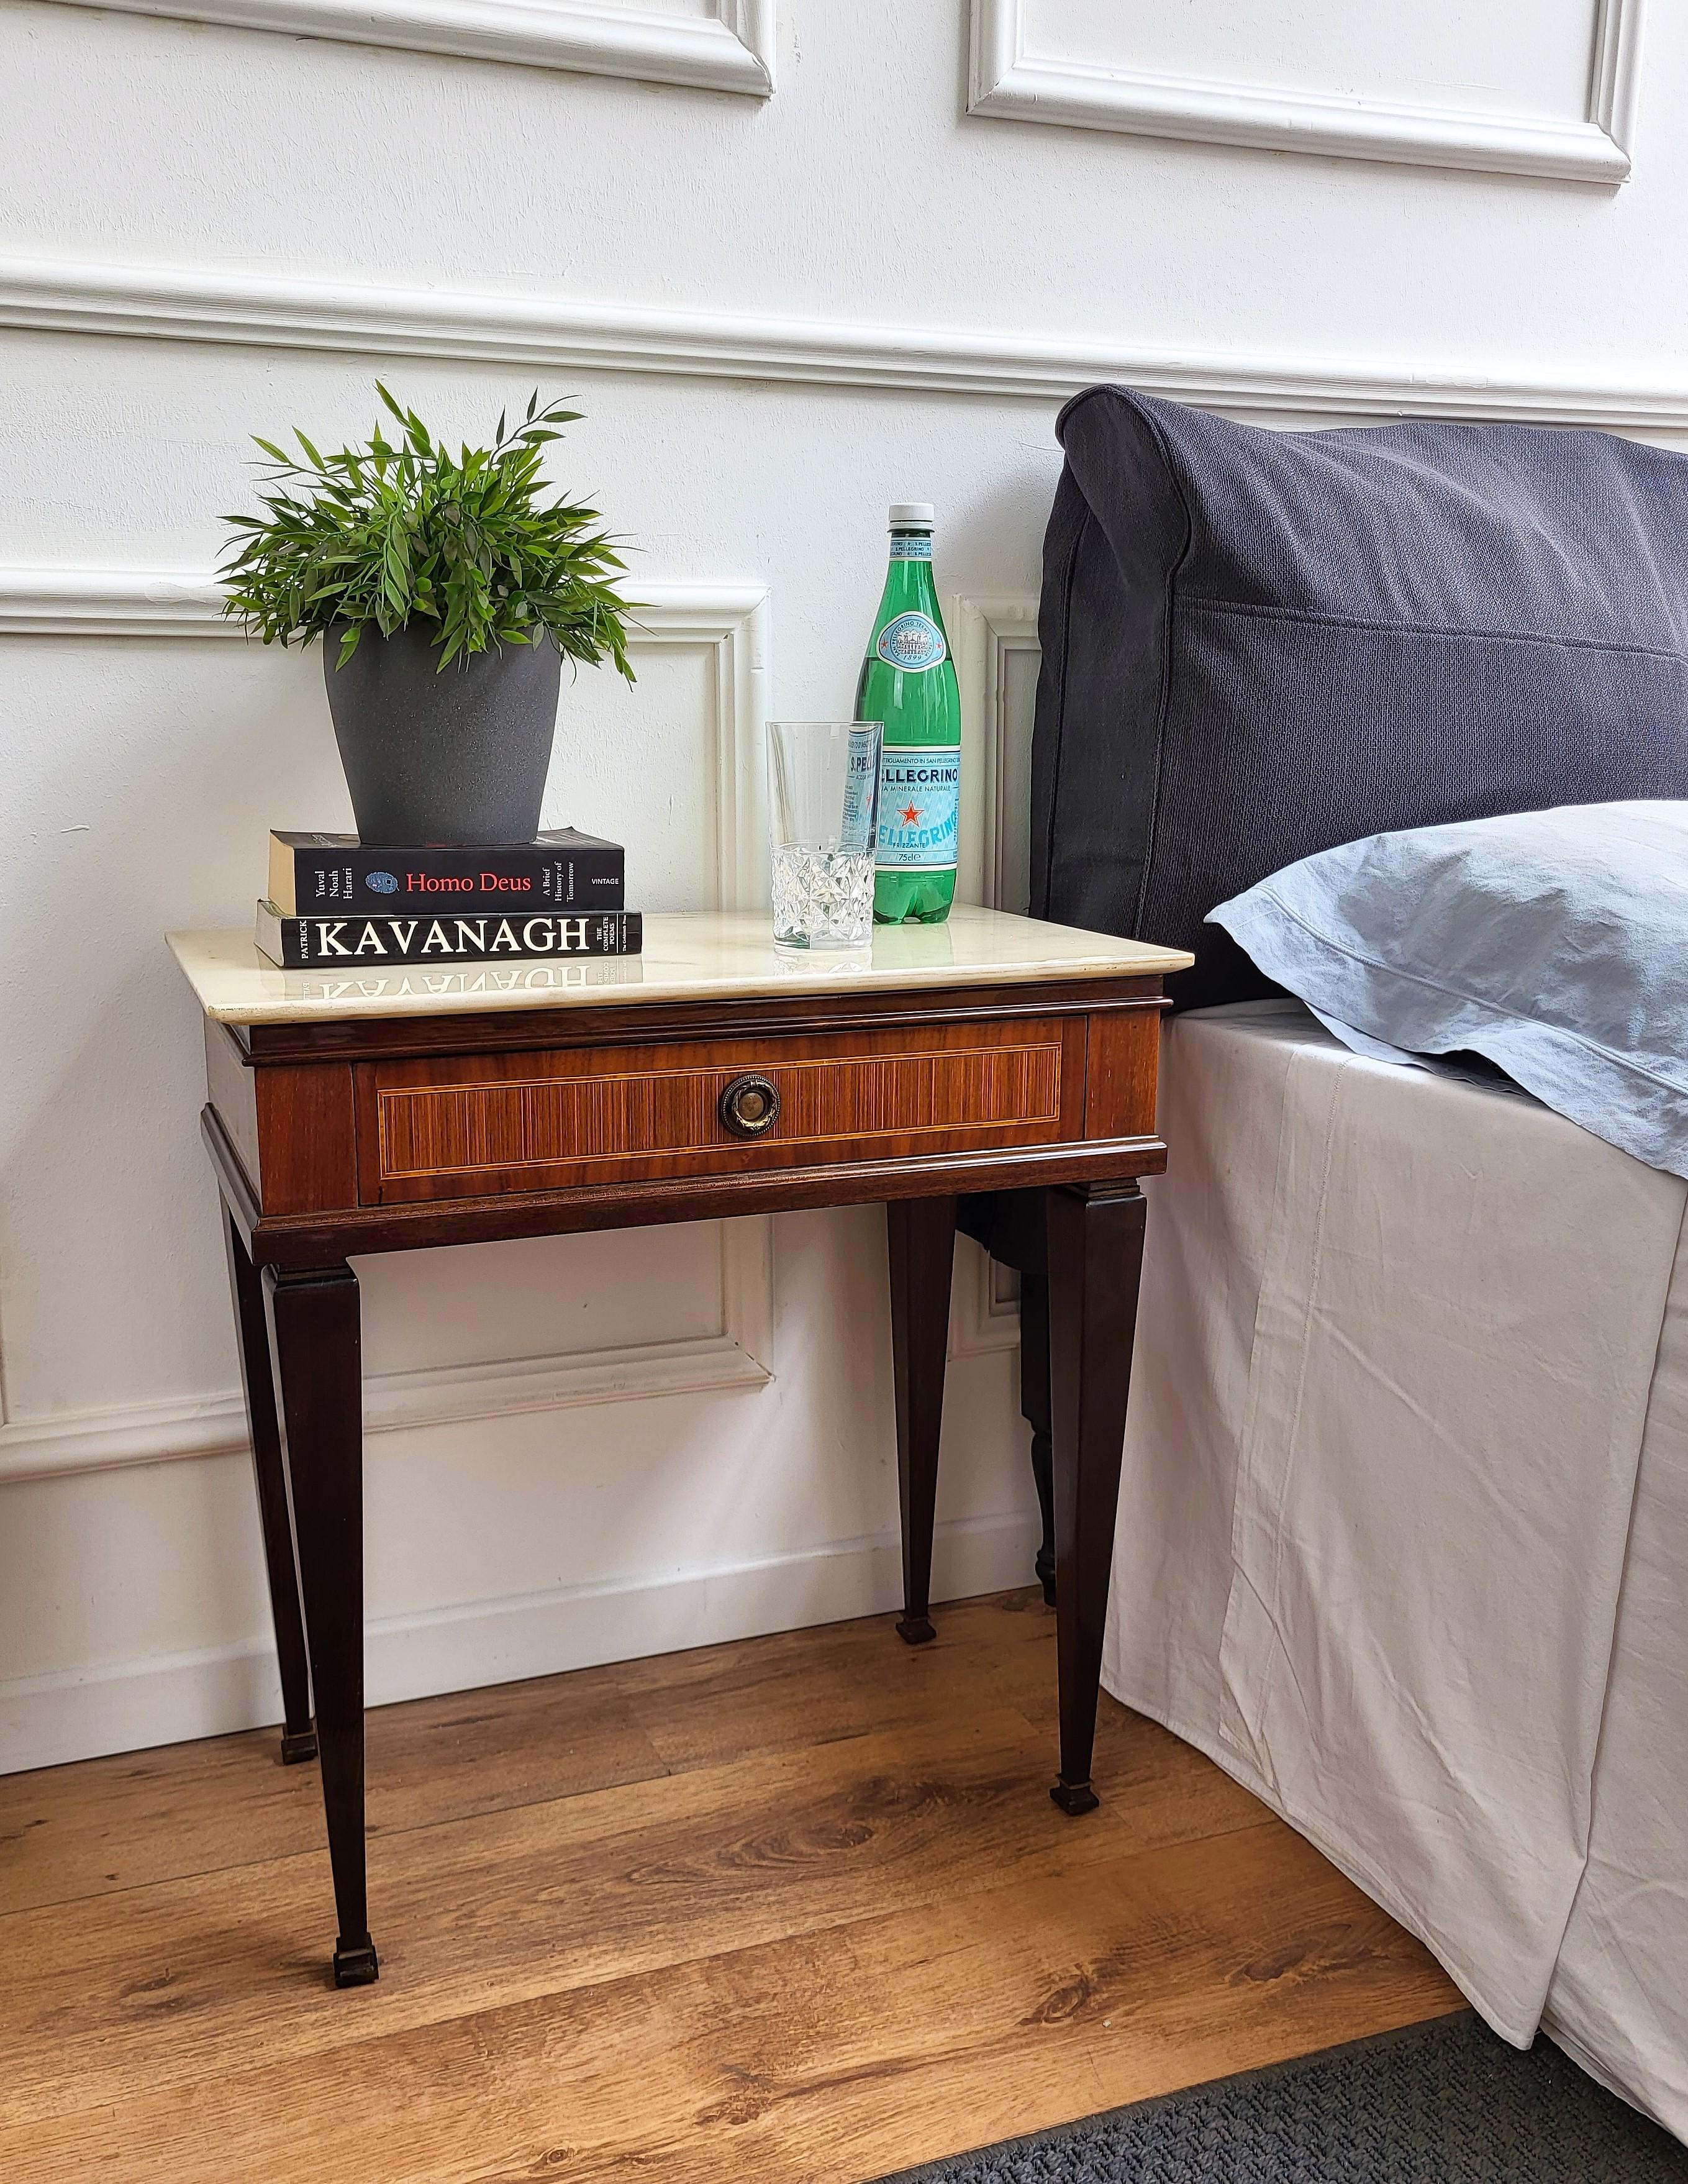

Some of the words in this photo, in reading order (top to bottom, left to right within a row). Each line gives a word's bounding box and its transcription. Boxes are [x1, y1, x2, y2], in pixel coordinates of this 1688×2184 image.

[542, 867, 550, 887] Brief
[554, 861, 562, 871] of
[314, 870, 325, 898] Yuval
[328, 870, 339, 898] Noah
[342, 868, 353, 900] Harari
[406, 873, 474, 892] Homo
[479, 873, 532, 891] Deus
[555, 872, 564, 901] History
[299, 920, 309, 960] PATRICK
[315, 918, 590, 957] KAVANAGH
